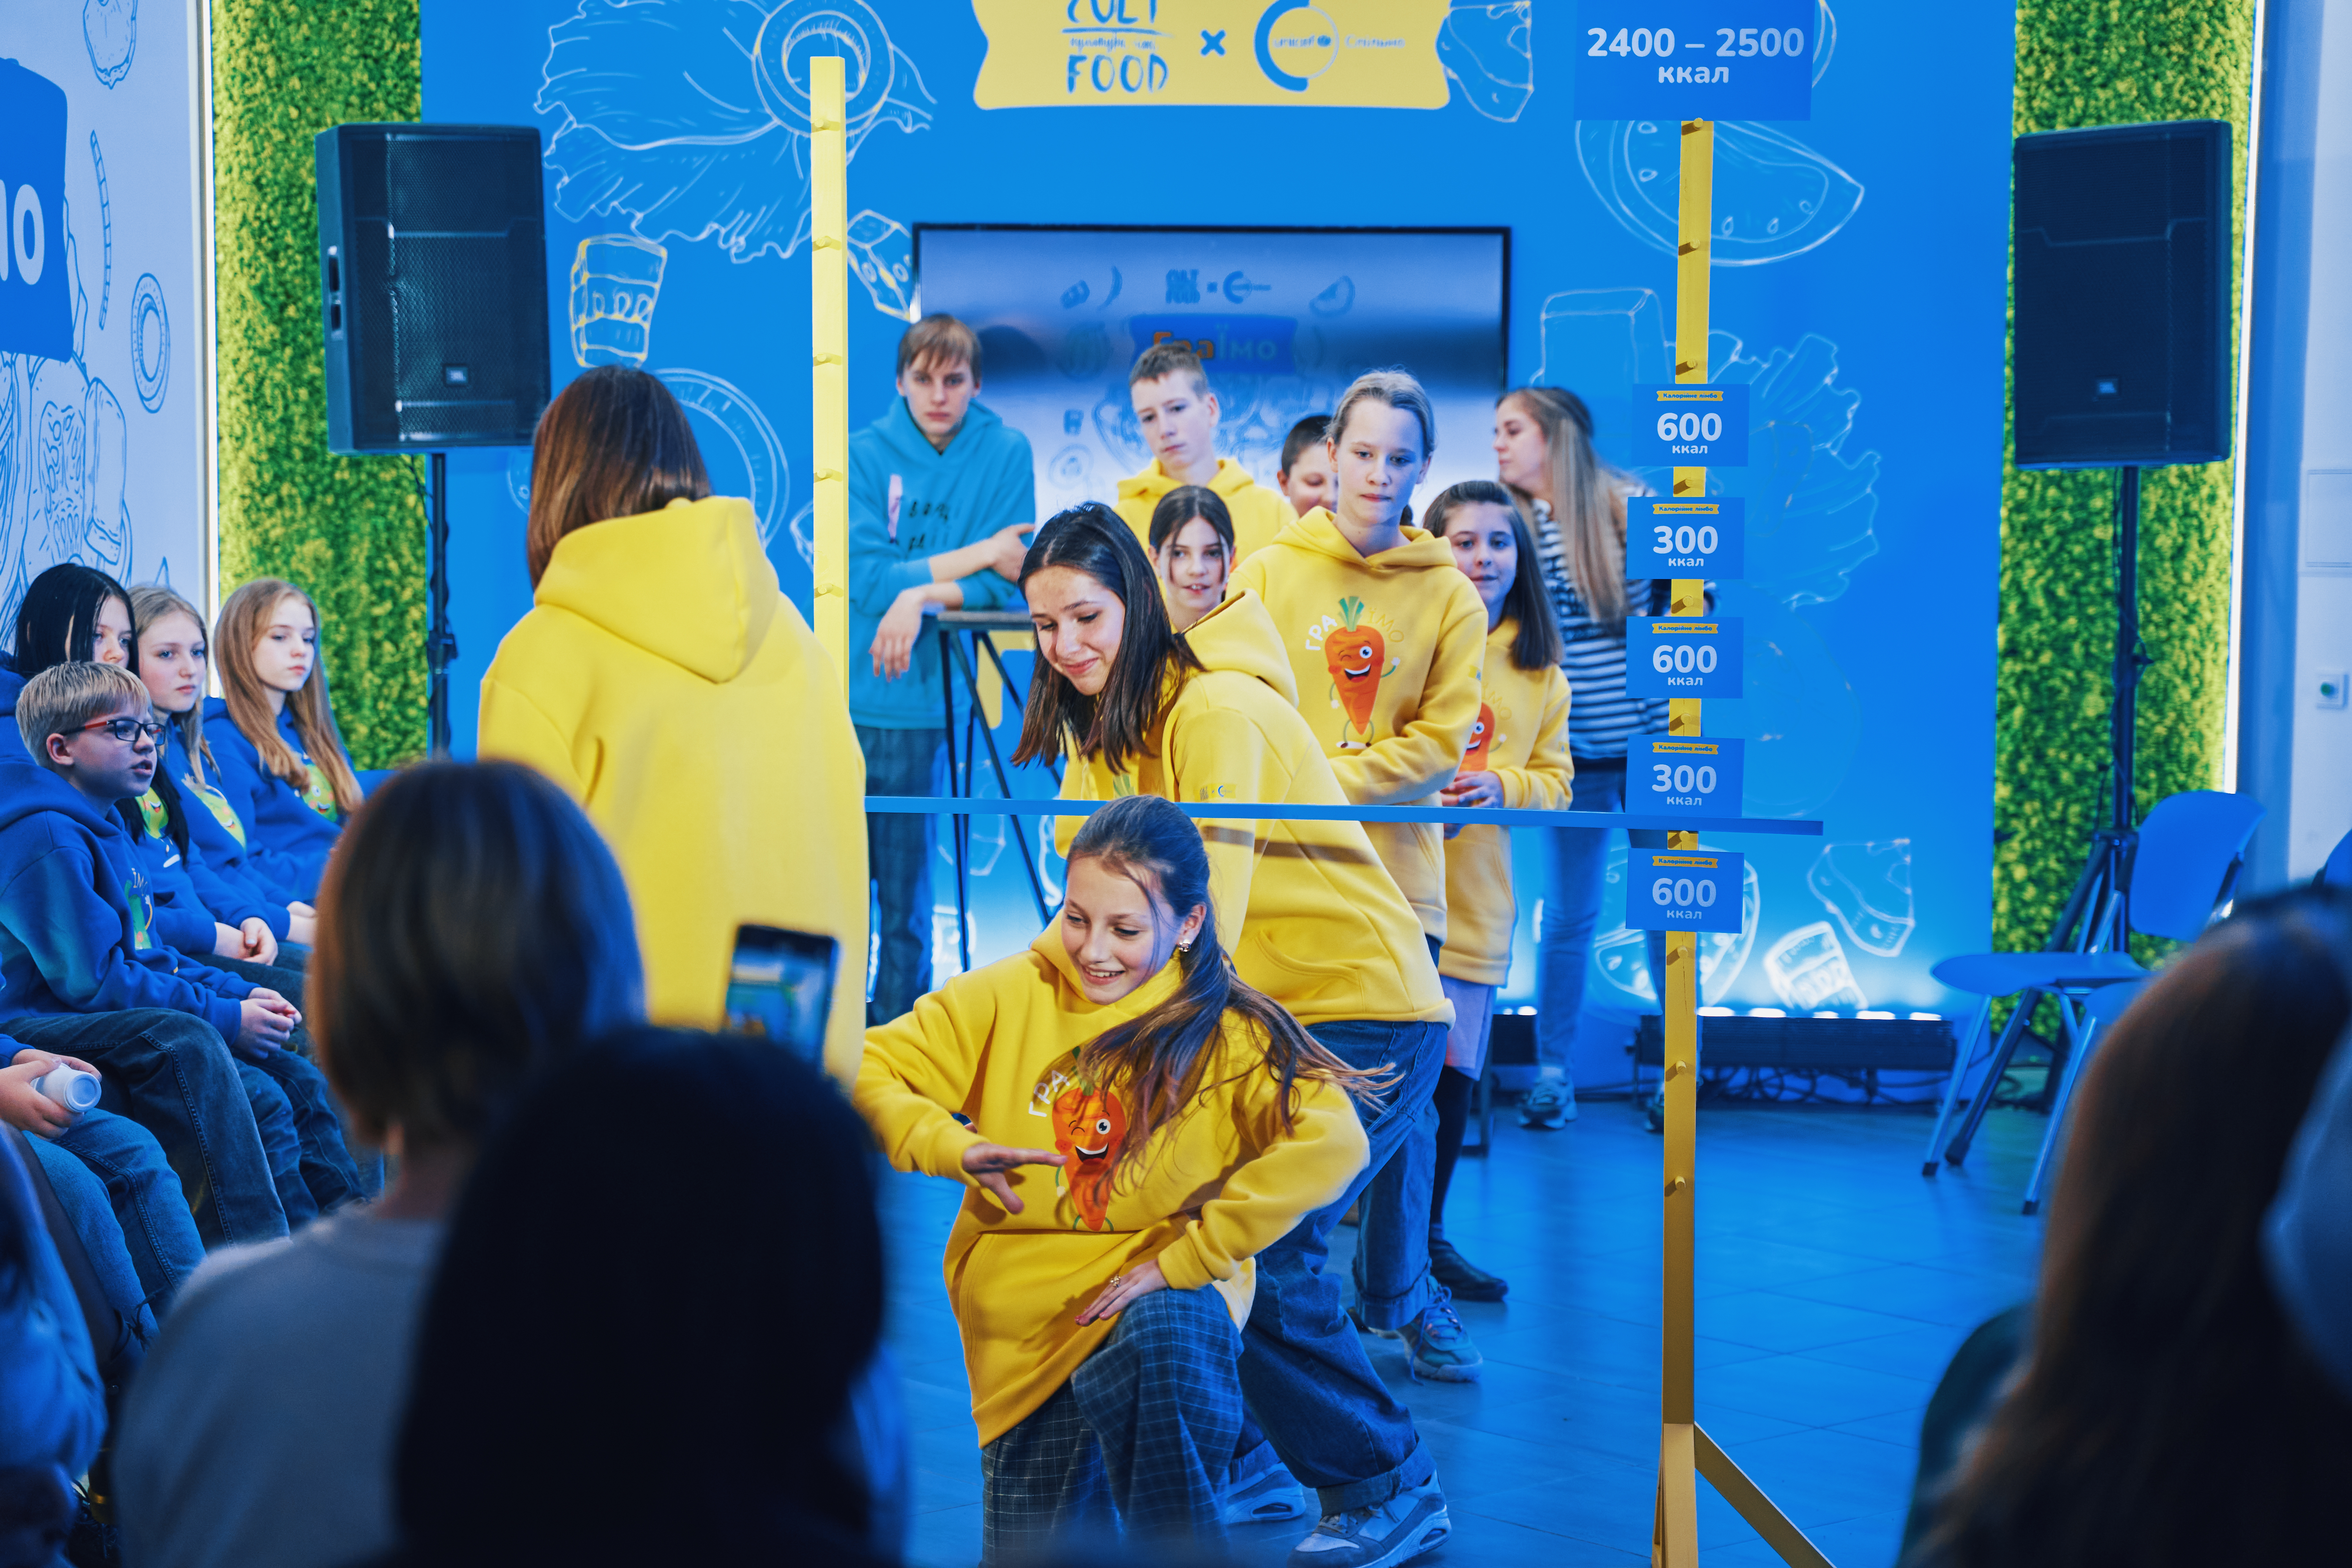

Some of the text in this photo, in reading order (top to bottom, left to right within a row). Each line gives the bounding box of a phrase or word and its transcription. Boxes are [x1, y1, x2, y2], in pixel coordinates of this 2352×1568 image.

[1588, 27, 1675, 57] 2400
[1716, 27, 1804, 57] 2500
[1066, 53, 1169, 94] FOOD
[1658, 66, 1729, 83] ккал
[1657, 412, 1722, 441] 600
[1672, 445, 1708, 454] ккал
[1653, 525, 1718, 554] 300
[1668, 558, 1704, 566] ккал
[1305, 614, 1338, 651] ГРА
[1653, 645, 1717, 673] 600
[1668, 677, 1703, 686] ккал
[1652, 764, 1717, 793] 300
[1667, 797, 1702, 806] ккал
[1652, 878, 1716, 907] 600
[1667, 910, 1702, 919] ккал
[1028, 1069, 1071, 1118] ГРА
